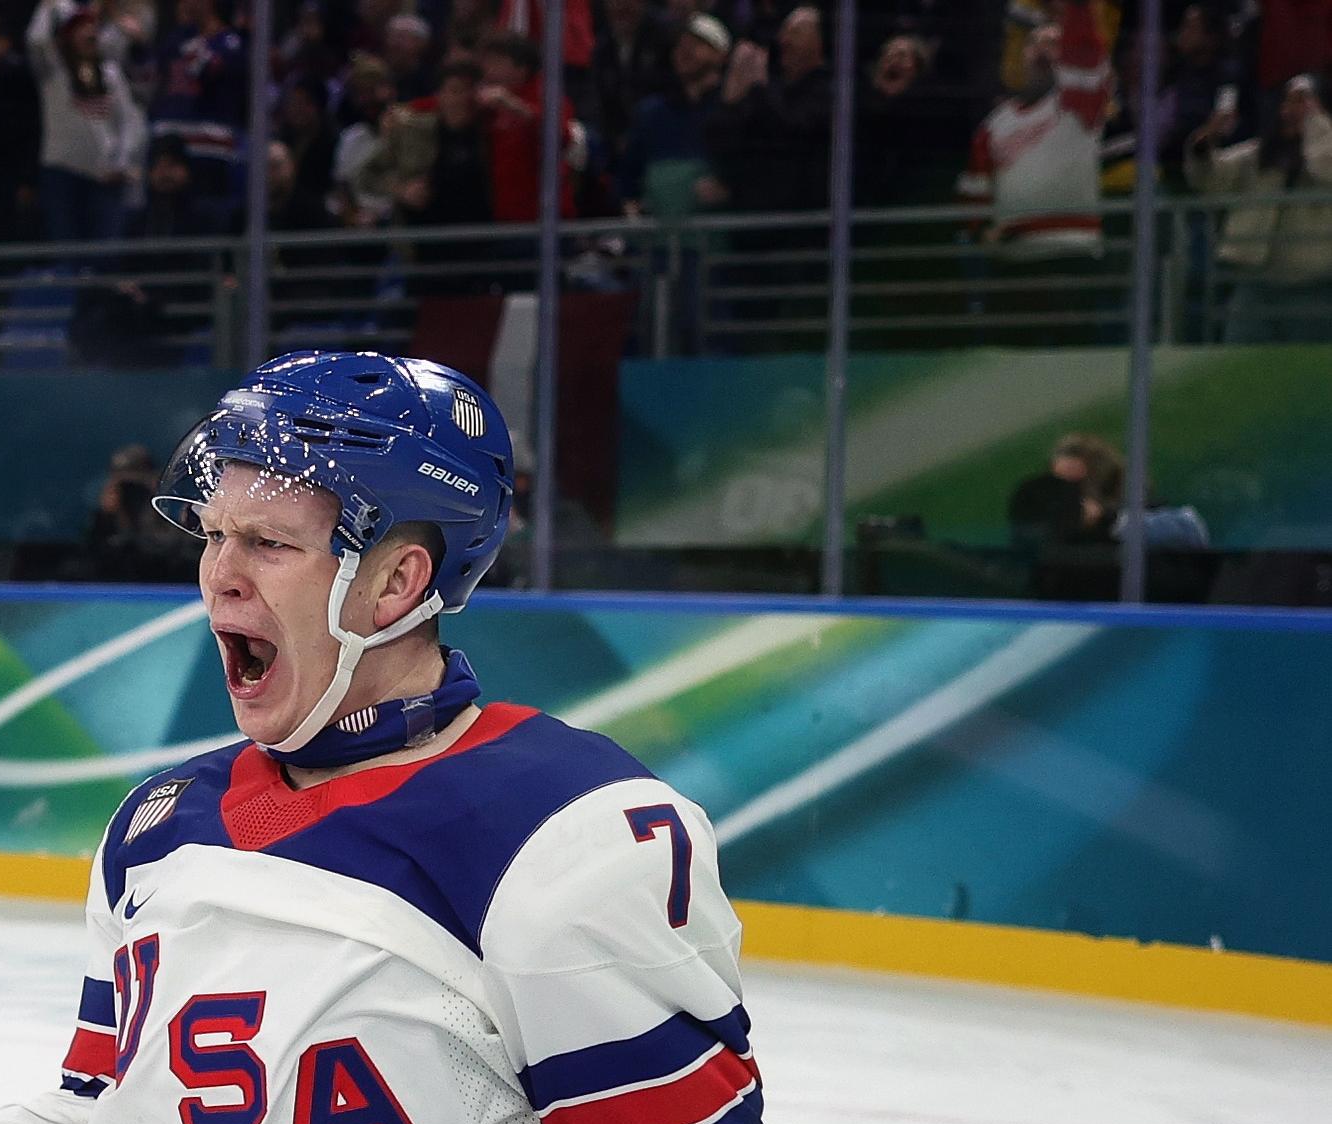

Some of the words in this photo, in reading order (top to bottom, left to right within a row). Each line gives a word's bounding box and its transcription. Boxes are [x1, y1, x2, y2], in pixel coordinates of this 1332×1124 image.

[456, 389, 479, 406] USA
[417, 460, 481, 497] BAUER
[337, 524, 364, 551] BAUER
[148, 783, 179, 800] USA
[623, 802, 693, 930] 7
